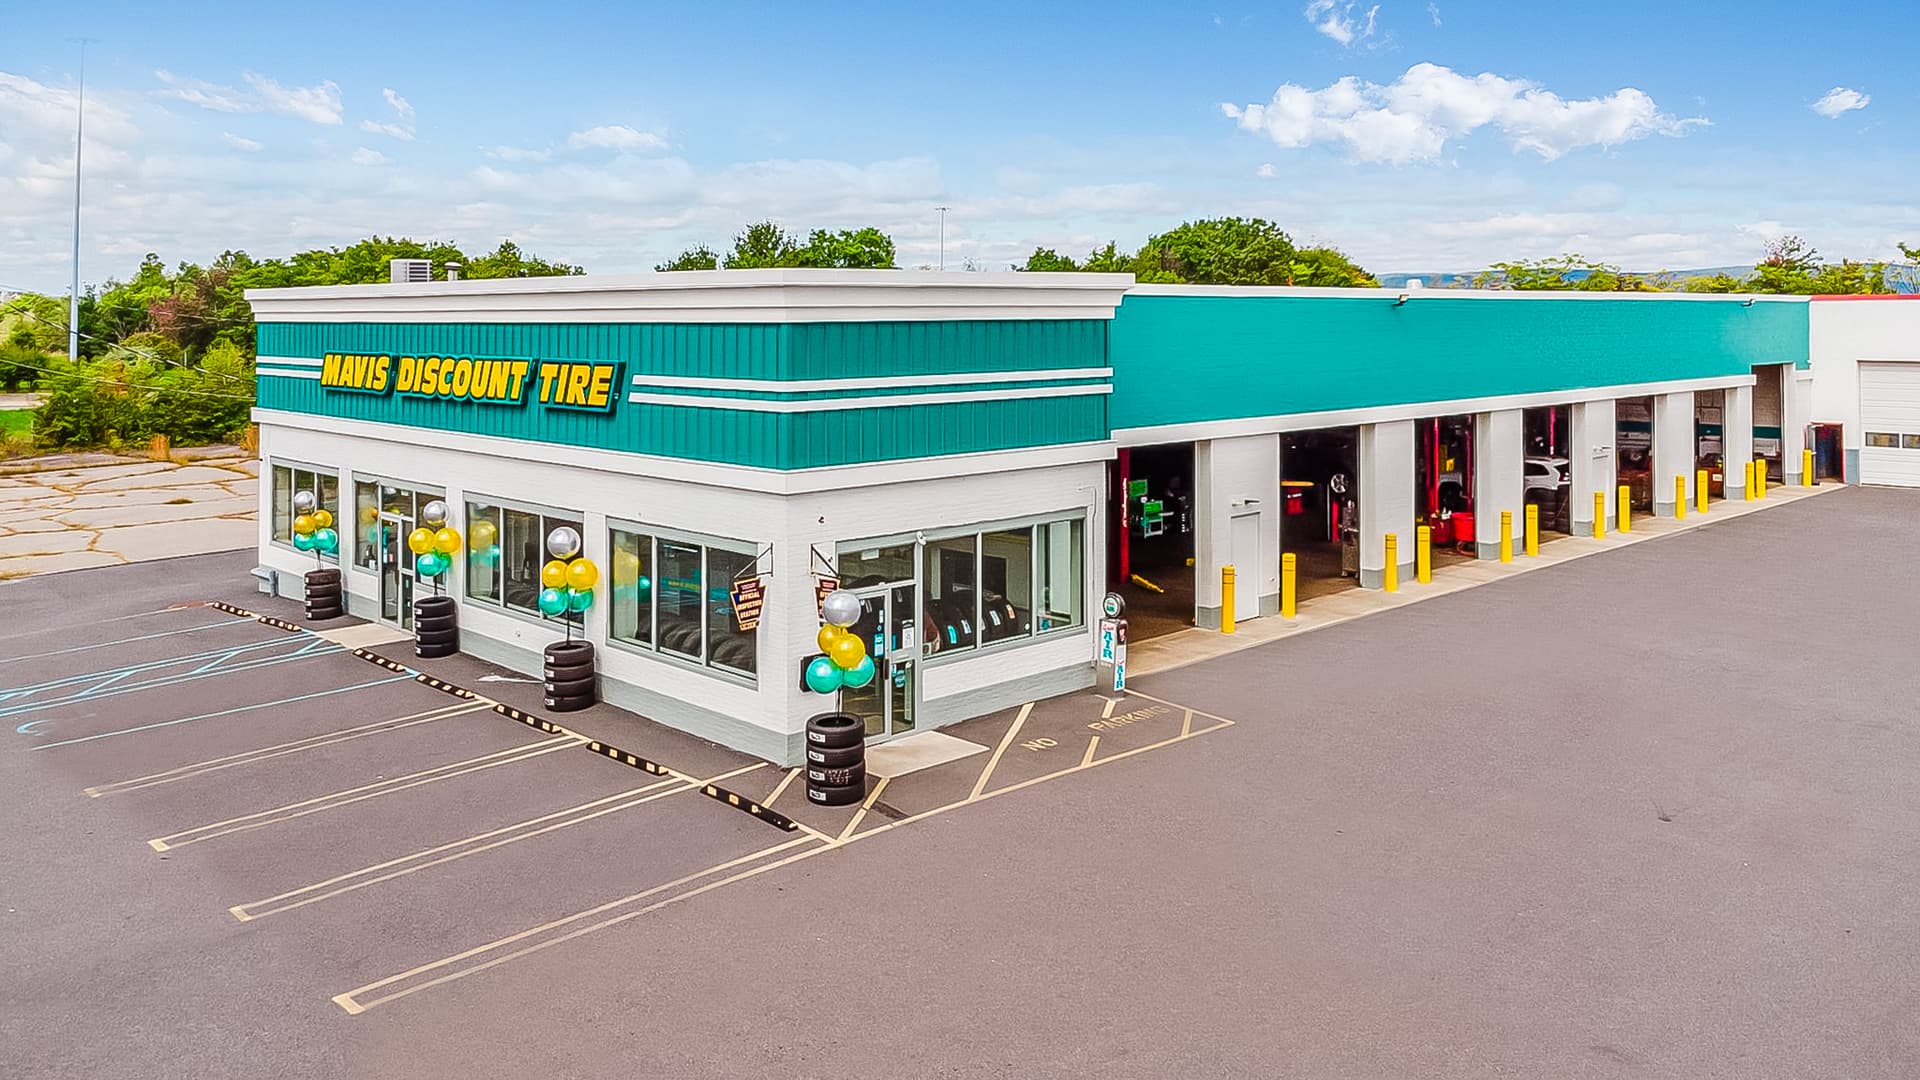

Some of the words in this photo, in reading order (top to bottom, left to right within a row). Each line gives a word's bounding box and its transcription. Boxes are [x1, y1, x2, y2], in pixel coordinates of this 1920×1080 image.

[322, 354, 389, 389] MAVIS
[397, 357, 528, 399] DISCOUNT
[539, 363, 614, 406] TIRE
[739, 591, 759, 601] OFFICIAL
[1103, 631, 1113, 659] AIR
[1116, 665, 1124, 689] AIR
[1020, 737, 1058, 751] NO
[1087, 705, 1170, 731] PARKING
